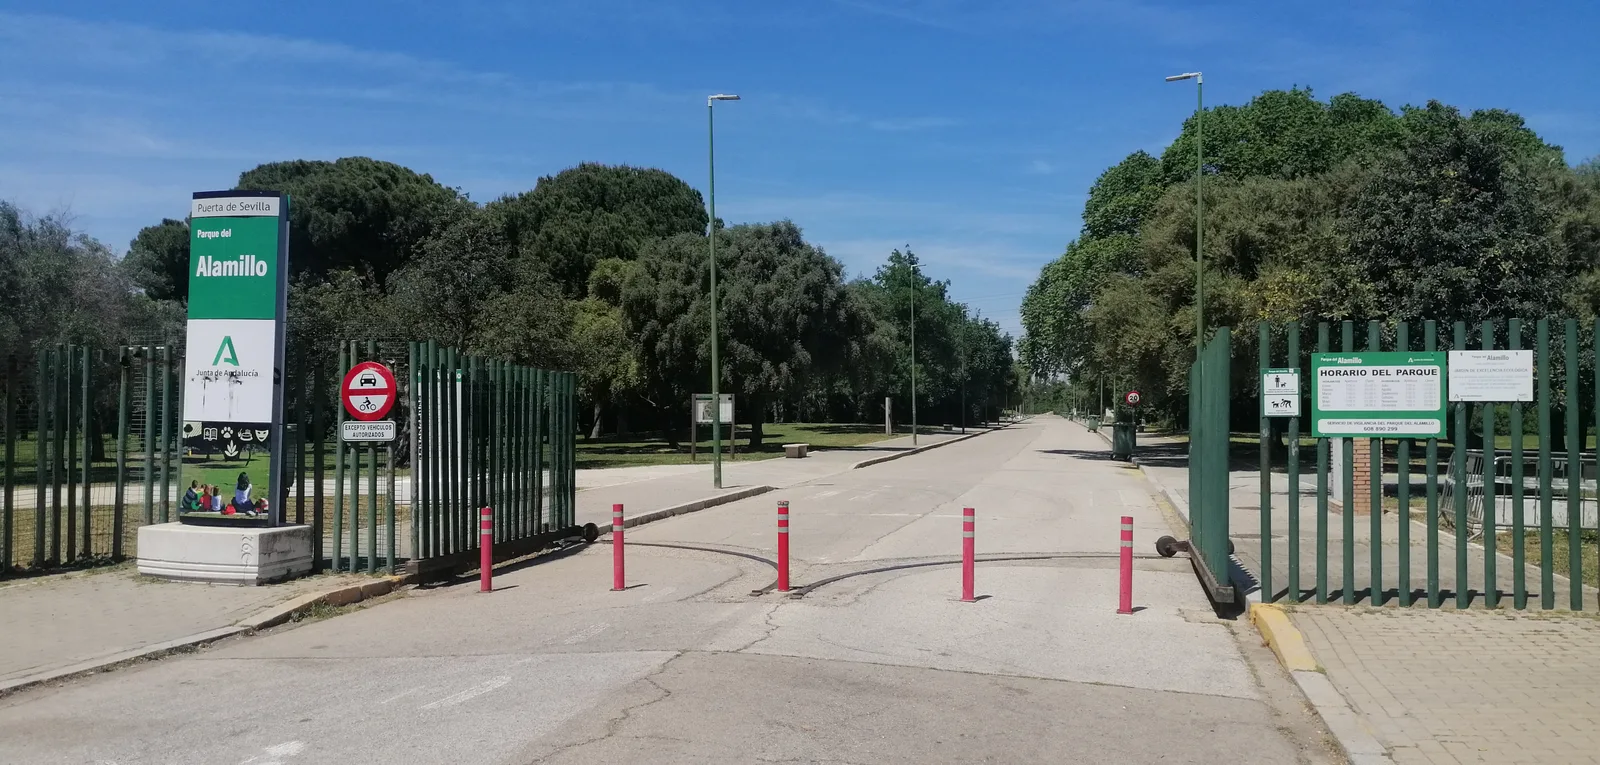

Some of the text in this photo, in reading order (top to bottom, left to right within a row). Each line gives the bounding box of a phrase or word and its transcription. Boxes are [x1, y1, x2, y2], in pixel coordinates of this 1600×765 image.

[197, 201, 271, 212] Puerta de Sevilla
[197, 228, 232, 239] Parque del
[195, 254, 268, 277] Alamillo
[1338, 356, 1362, 364] Alamillo
[223, 369, 259, 378] Andalucía
[1320, 369, 1367, 377] HORARIO
[1396, 368, 1438, 376] PARQUE
